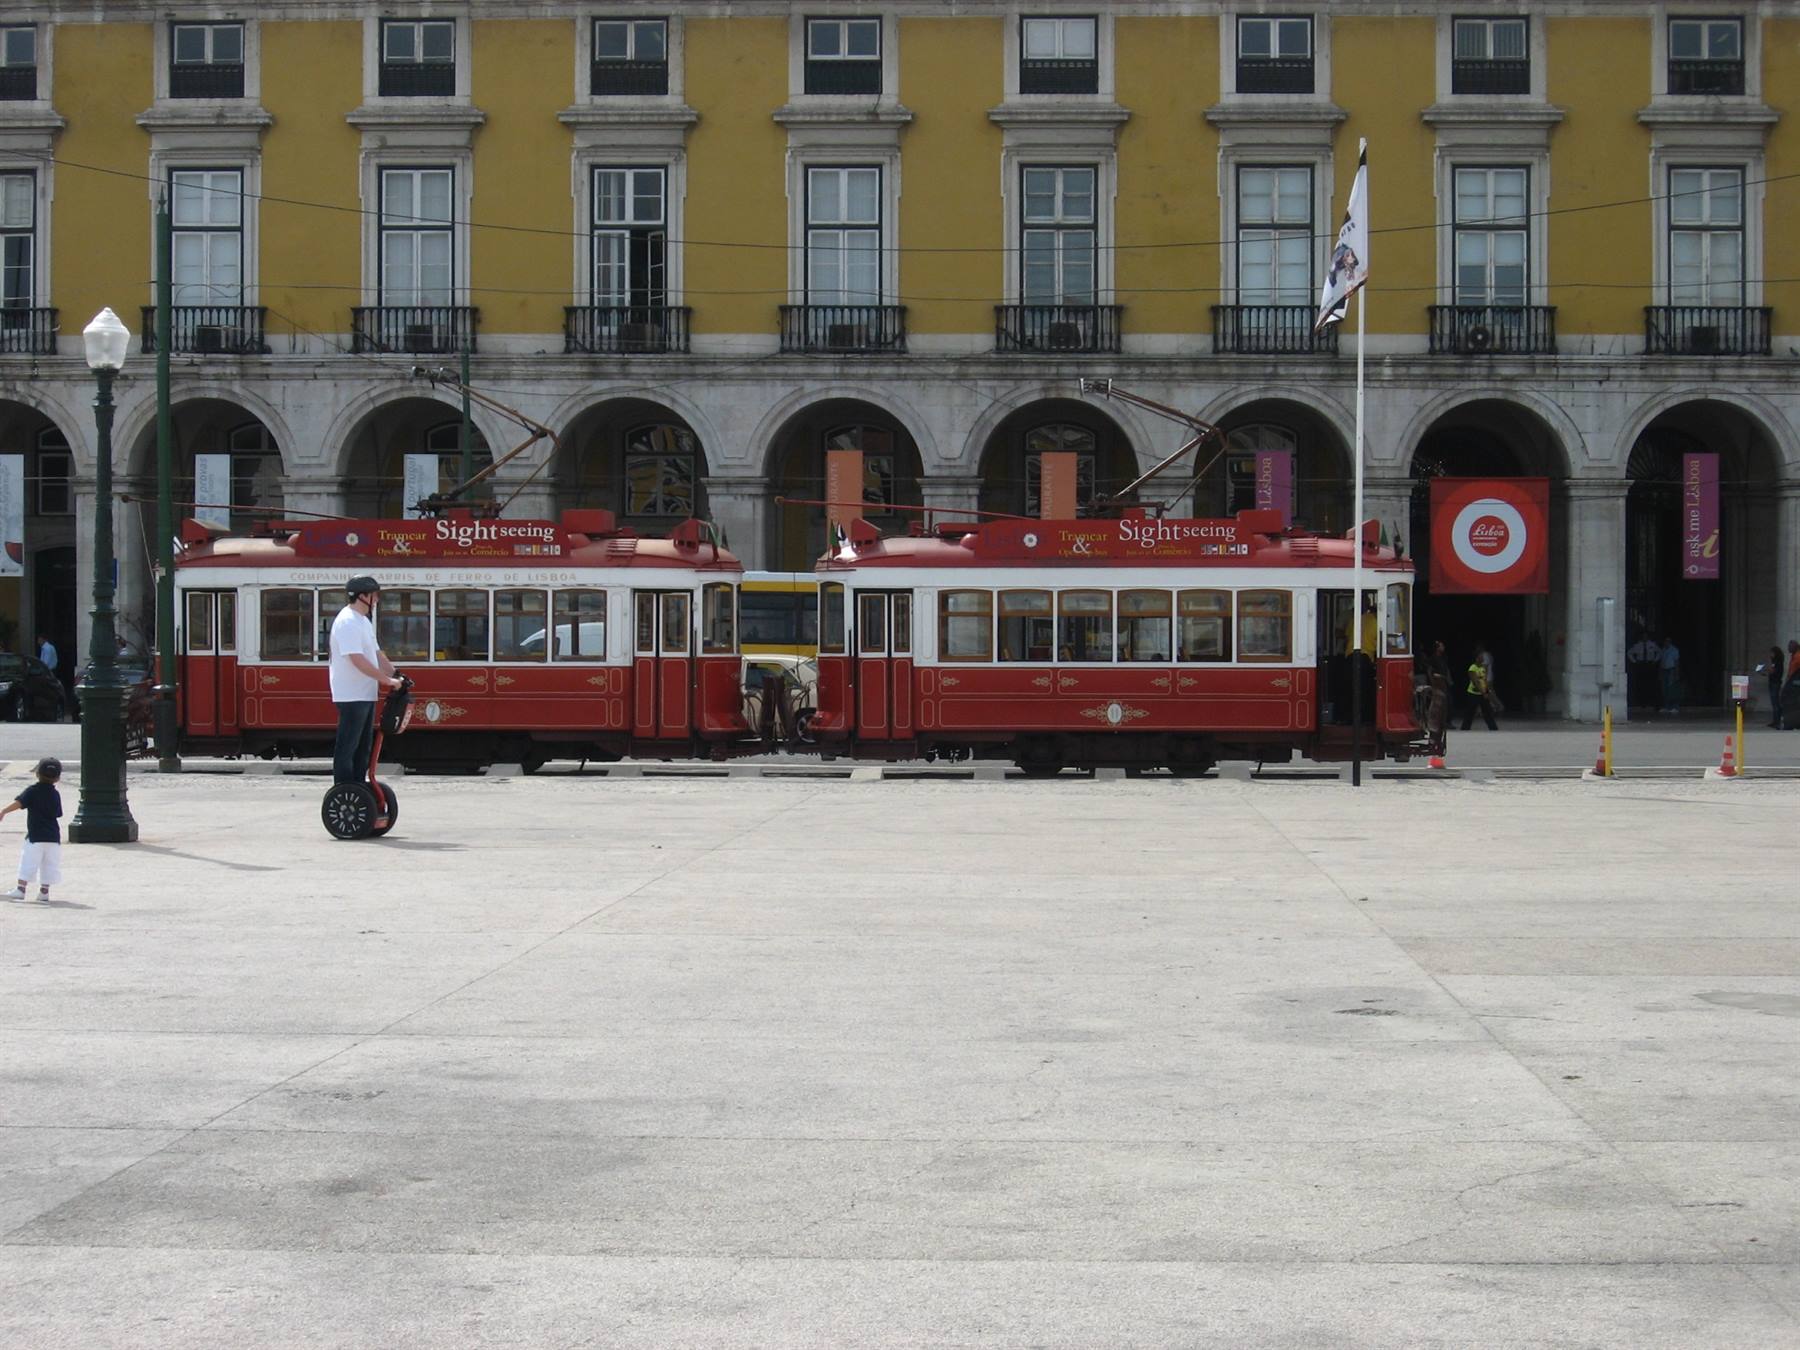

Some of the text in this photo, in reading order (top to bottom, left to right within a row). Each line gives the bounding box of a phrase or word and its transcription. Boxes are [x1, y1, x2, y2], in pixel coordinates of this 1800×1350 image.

[1690, 509, 1700, 531] me
[378, 530, 427, 541] Tramcar
[436, 519, 555, 547] Sight seeing
[1059, 530, 1108, 541] Tramcar
[1119, 519, 1237, 548] Sight seeing
[1686, 536, 1700, 558] ask
[290, 573, 361, 582] COMPANHI
[425, 573, 440, 581] DE
[450, 573, 493, 581] FERRO
[504, 573, 519, 581] DE
[528, 573, 577, 581] LISBOA
